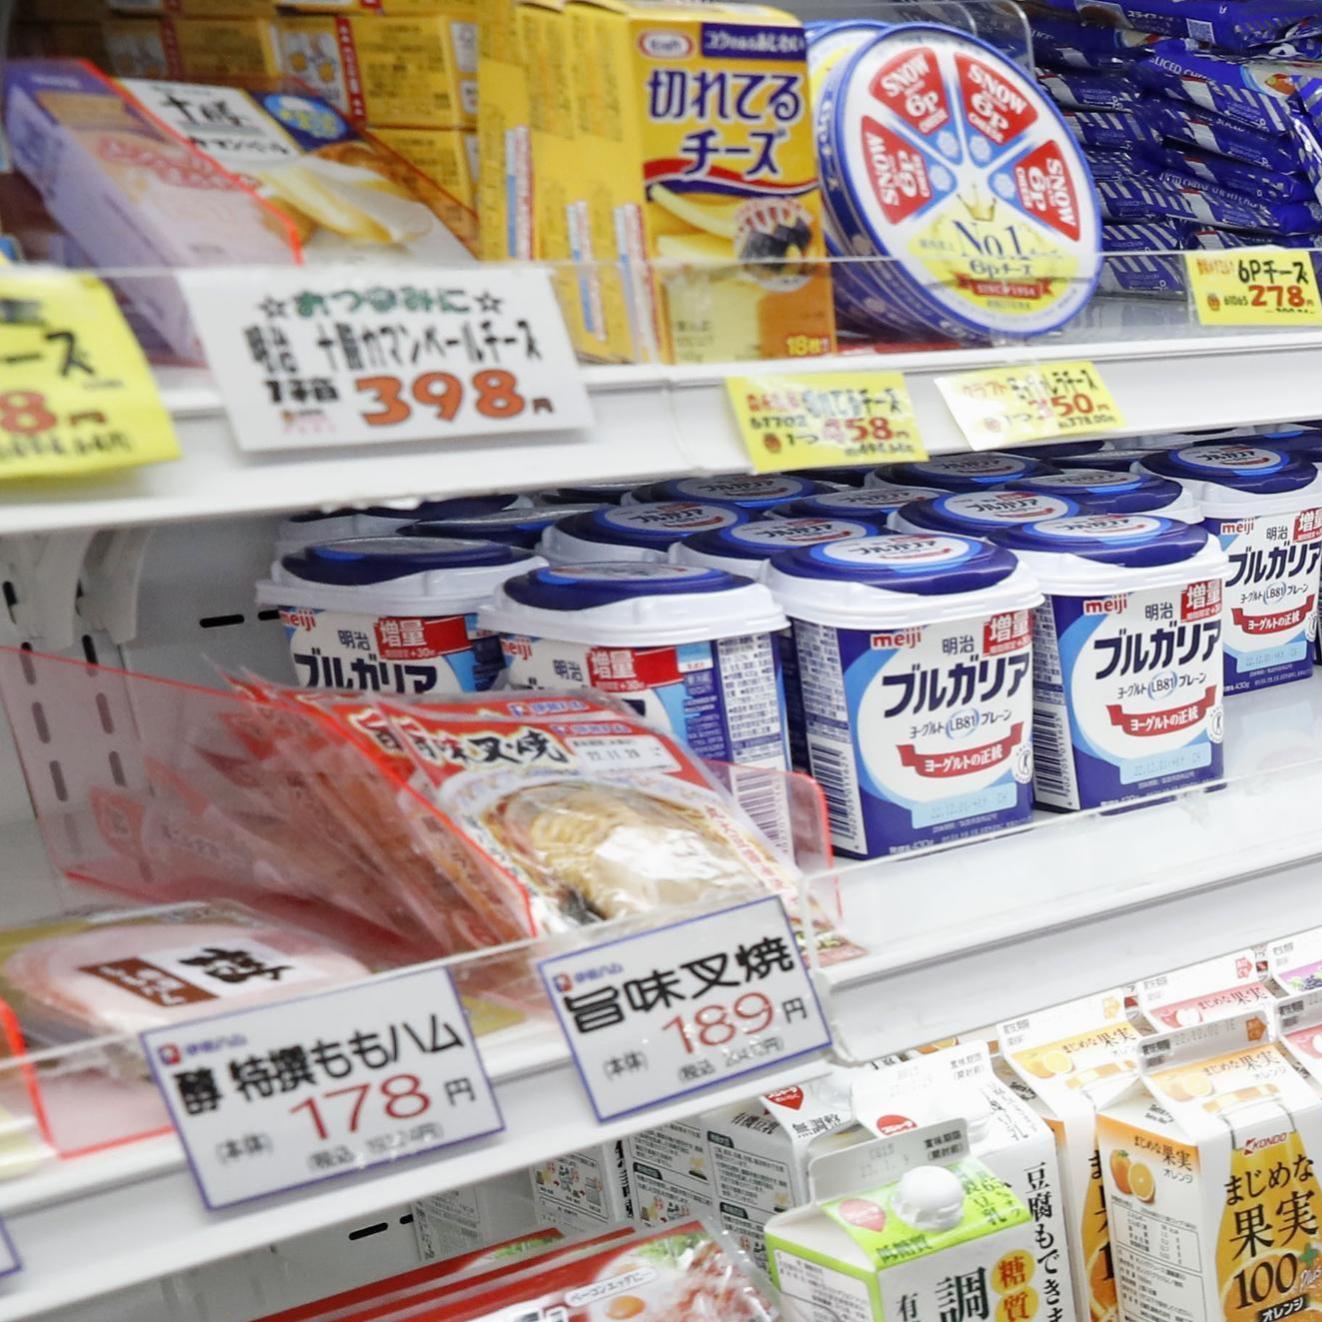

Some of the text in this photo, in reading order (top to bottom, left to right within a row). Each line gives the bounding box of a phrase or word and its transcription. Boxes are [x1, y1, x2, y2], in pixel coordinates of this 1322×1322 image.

[648, 69, 802, 124] 切れてる
[883, 60, 930, 103] SNOW
[968, 60, 1027, 112] SNOW
[680, 129, 781, 178] チーズ
[1227, 541, 1320, 585] ブルガリア
[871, 629, 922, 650] meiji
[941, 636, 975, 656] 明治
[1094, 622, 1222, 680] ブルガリア
[882, 655, 1031, 718] ブルガリア
[661, 991, 808, 1056] 189 円
[292, 1074, 476, 1142] 178 円
[1223, 1155, 1314, 1207] まじめな
[1232, 1190, 1321, 1261] 果実
[1234, 1252, 1298, 1310] 100
